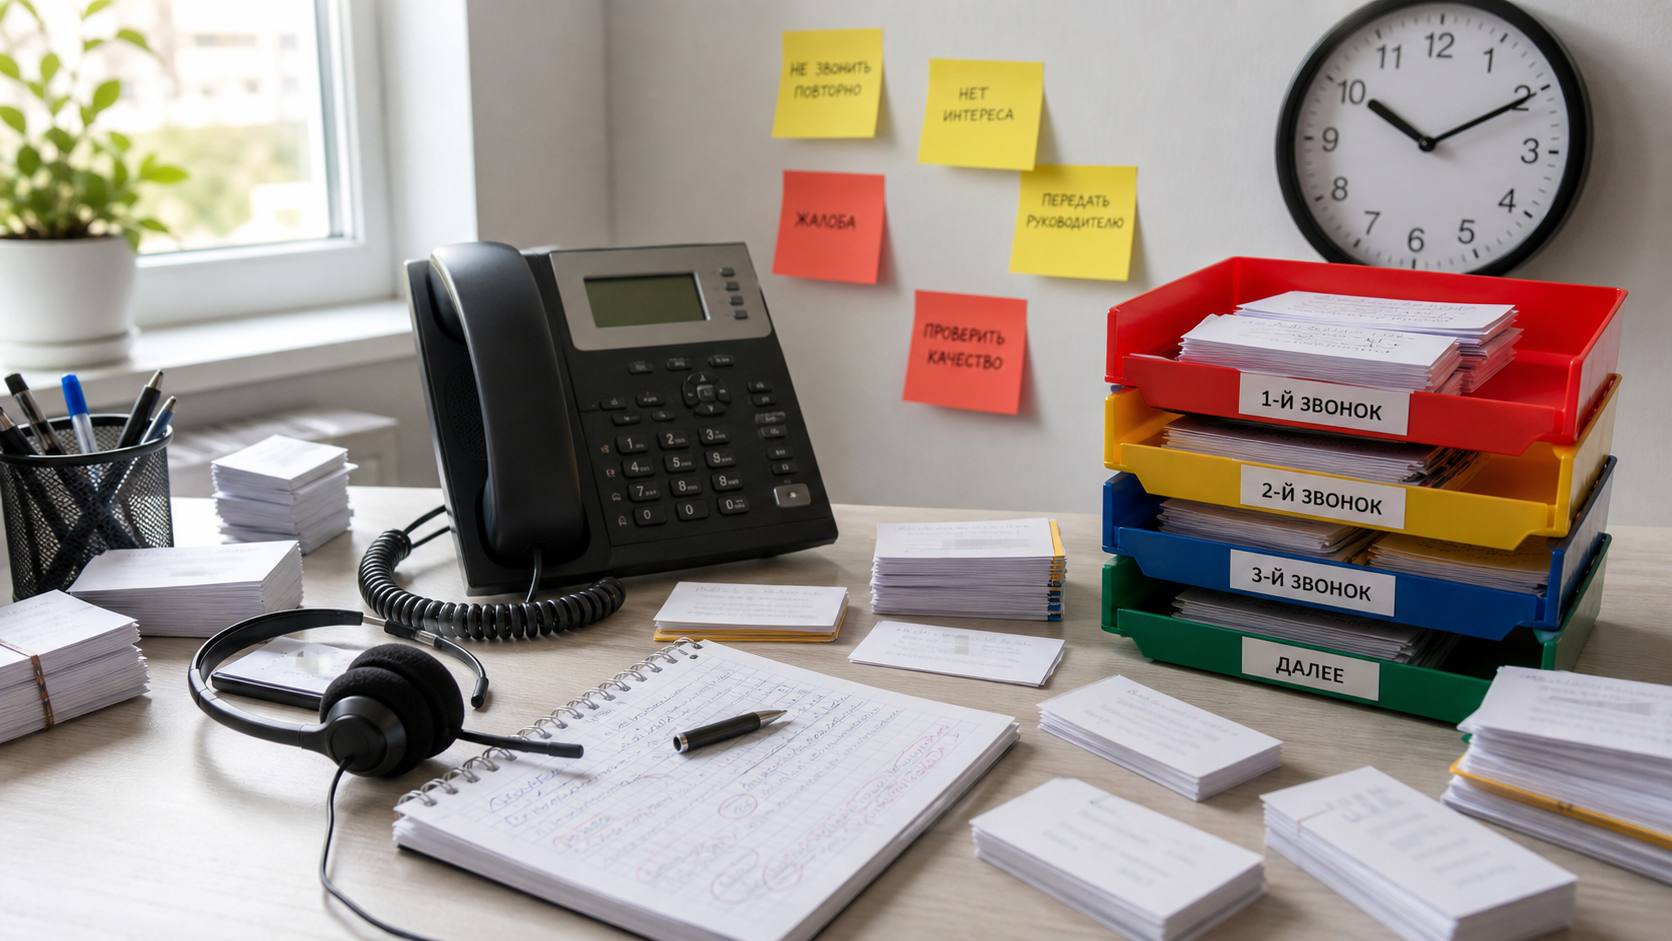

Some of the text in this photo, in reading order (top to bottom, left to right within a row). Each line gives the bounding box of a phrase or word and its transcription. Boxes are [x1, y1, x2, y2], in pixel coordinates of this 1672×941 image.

[1376, 44, 1402, 69] 11
[1424, 32, 1455, 58] 12
[789, 60, 872, 77] НЕ ЗВОНИТЬ
[1483, 47, 1494, 73] 1
[793, 83, 862, 99] ПОВТОРНО
[958, 86, 990, 101] НЕТ
[1337, 79, 1366, 105] 10
[1512, 84, 1532, 112] 2
[943, 107, 1014, 122] ИНТЕРЕСА
[1321, 127, 1339, 152] 9
[1520, 138, 1539, 164] 3
[1041, 192, 1110, 210] ПЕРЕДАТЬ
[1331, 176, 1348, 201] 8
[1498, 188, 1517, 213] 4
[793, 210, 857, 231] ЖАЛОБА
[1026, 214, 1125, 232] РУКОВОДИТЕЛЮ
[1364, 210, 1381, 235] 7
[1457, 219, 1475, 244] 5
[1407, 227, 1425, 252] 6
[923, 322, 1006, 346] ПРОВЕРИТЬ
[926, 349, 1004, 371] КАЧЕСТВО
[1261, 389, 1382, 421] 1-Й ЗВОНОК
[627, 437, 633, 449] 1
[666, 433, 675, 445] 2
[706, 428, 714, 440] 3
[631, 461, 639, 473] 4
[636, 485, 644, 497] 7
[678, 480, 687, 491] 8
[1261, 482, 1382, 515] 2-Й ЗВОНОК
[1251, 567, 1371, 601] 3-Й ЗВОНОК
[1275, 656, 1344, 684] ДАЛЕЕ
